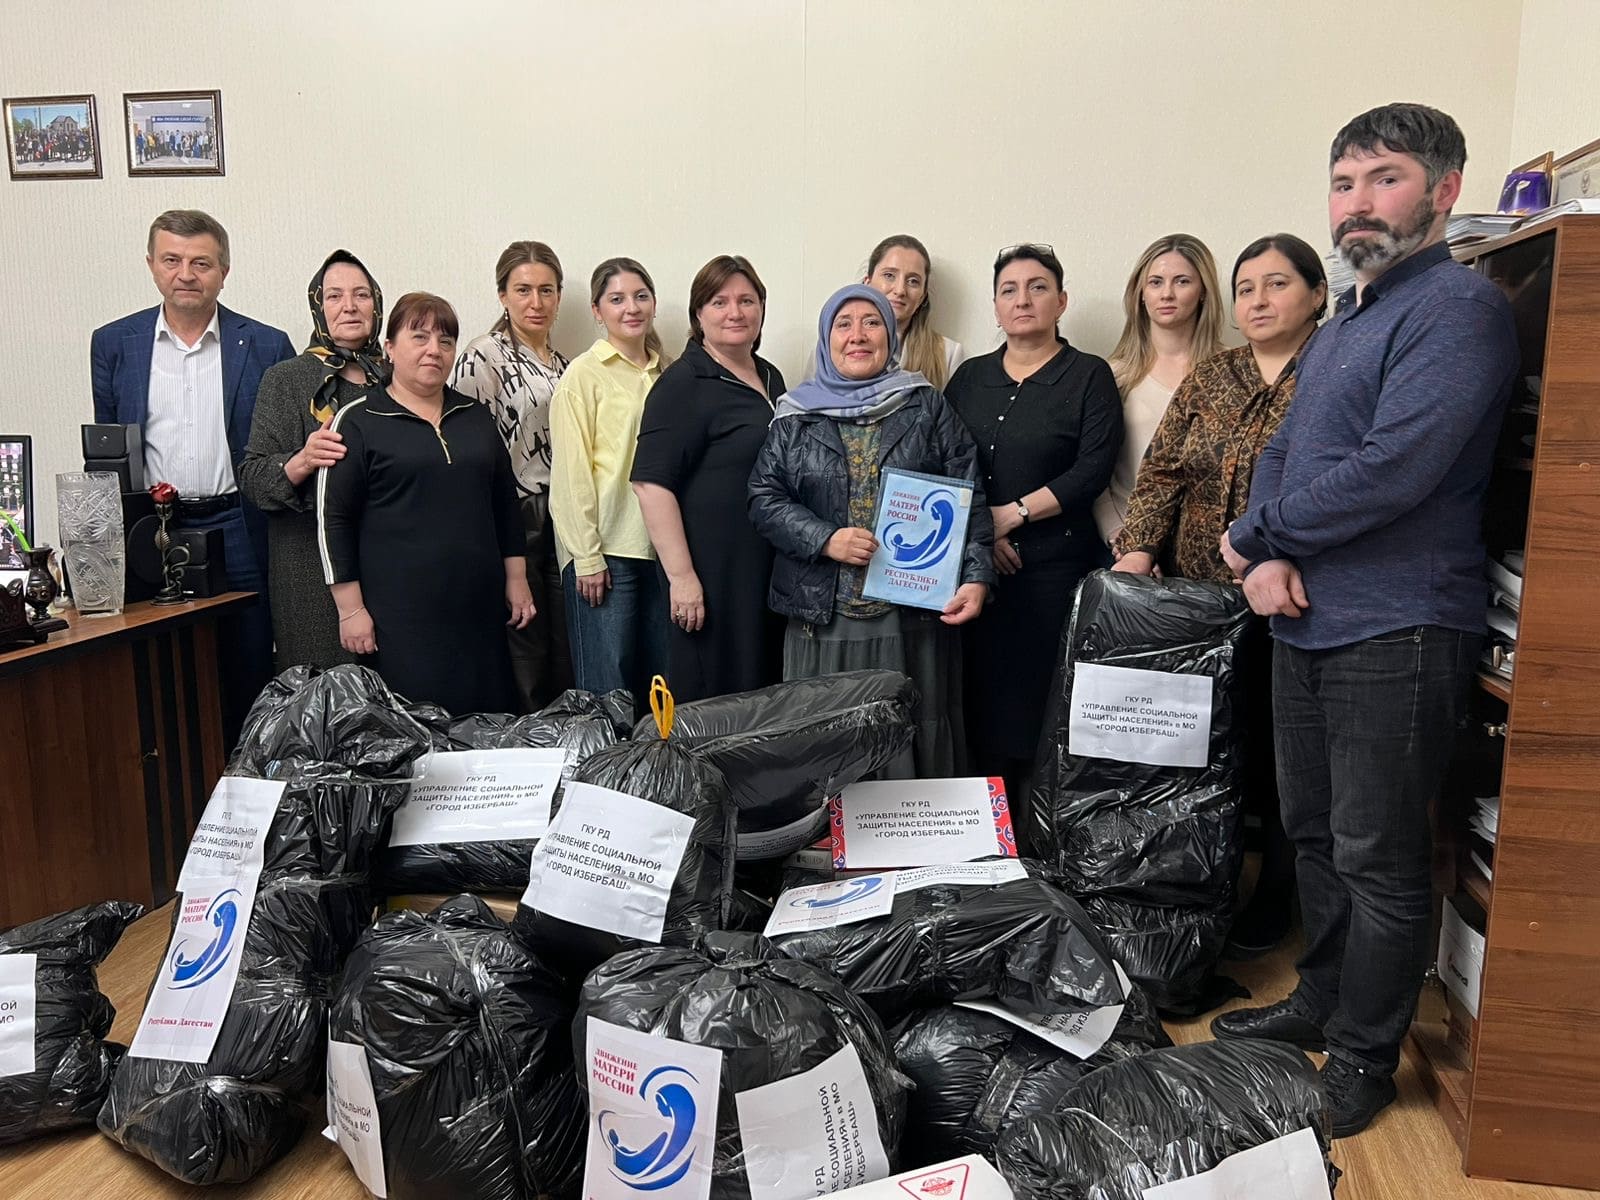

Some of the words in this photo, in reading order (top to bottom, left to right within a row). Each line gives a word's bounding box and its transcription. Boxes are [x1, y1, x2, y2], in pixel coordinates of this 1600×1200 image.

[889, 499, 920, 512] МАТЕРИ
[887, 509, 918, 522] РОССИИ
[884, 568, 938, 585] РЕСПУБЛИКИ
[888, 577, 930, 592] ДАГЕСТАН
[1141, 696, 1153, 705] РД
[1081, 703, 1137, 714] «УПРАВЛЕНИЕ
[1139, 707, 1198, 720] СОЦИАЛЬНОЙ
[1082, 712, 1118, 722] ЗАЩИТЫ
[1119, 717, 1173, 727] НАСЕЛЕНИЯ»
[1182, 722, 1196, 730] МО
[1096, 724, 1127, 733] «ГОРОД
[1129, 726, 1179, 737] ИЗБЕРБАШ»
[413, 785, 477, 793] «УПРАВЛЕНИЕ
[480, 783, 544, 793] СОЦИАЛЬНОЙ
[918, 800, 931, 808] РД
[855, 811, 917, 821] «УПРАВЛЕНИЕ
[918, 808, 980, 819] СОЦИАЛЬНОЙ
[581, 824, 597, 835] ГКУ
[597, 828, 611, 840] РД
[857, 821, 897, 830] ЗАЩИТЫ
[898, 819, 956, 828] НАСЕЛЕНИЯ»
[875, 830, 909, 838] «ГОРОД
[910, 828, 965, 837] ИЗБЕРБАШ»
[592, 843, 662, 871] СОЦИАЛЬНОЙ
[546, 860, 573, 876] «ГОРОД
[573, 868, 632, 891] ИЗБЕРБАШ»
[567, 851, 626, 876] НАСЕЛЕНИЯ»
[637, 873, 655, 884] МО
[178, 1018, 214, 1028] Дагестан
[595, 1048, 638, 1070] ДВИЖЕНИЕ
[593, 1056, 635, 1082] МАТЕРИ
[593, 1069, 634, 1095] РОССИИ
[831, 1082, 841, 1104] МО
[818, 1085, 840, 1178] СОЦИАЛЬНОЙ
[848, 1101, 866, 1180] ИЗБЕРБАШ»
[839, 1118, 853, 1190] АСЕЛЕНИЯ»
[815, 1166, 825, 1186] РД
